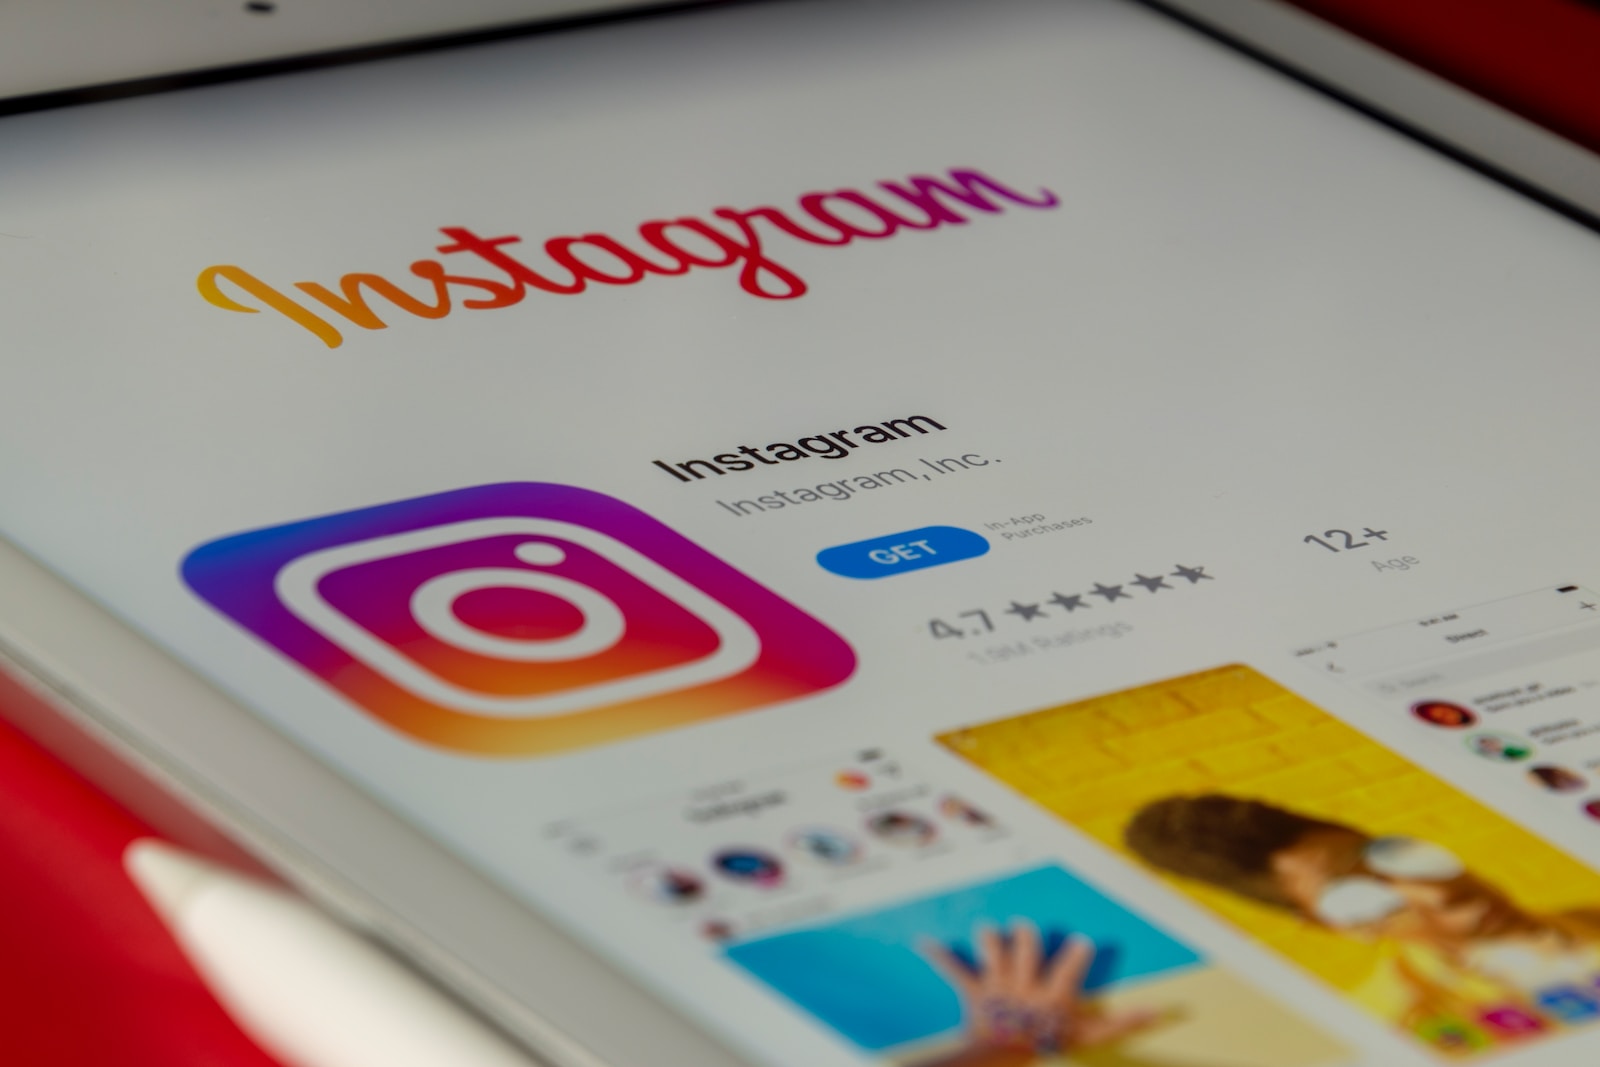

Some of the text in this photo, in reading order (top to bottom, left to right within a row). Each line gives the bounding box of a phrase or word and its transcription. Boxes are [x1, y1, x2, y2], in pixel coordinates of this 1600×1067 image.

[194, 167, 1061, 350] Instagram
[652, 414, 948, 483] Instagram
[715, 451, 1002, 517] Instagram, Inc.
[983, 513, 1046, 531] In-App
[1001, 517, 1093, 541] Purchases
[868, 539, 937, 565] GET
[1304, 527, 1389, 553] 12+
[1371, 553, 1420, 573] Age
[928, 609, 995, 640] 4.7
